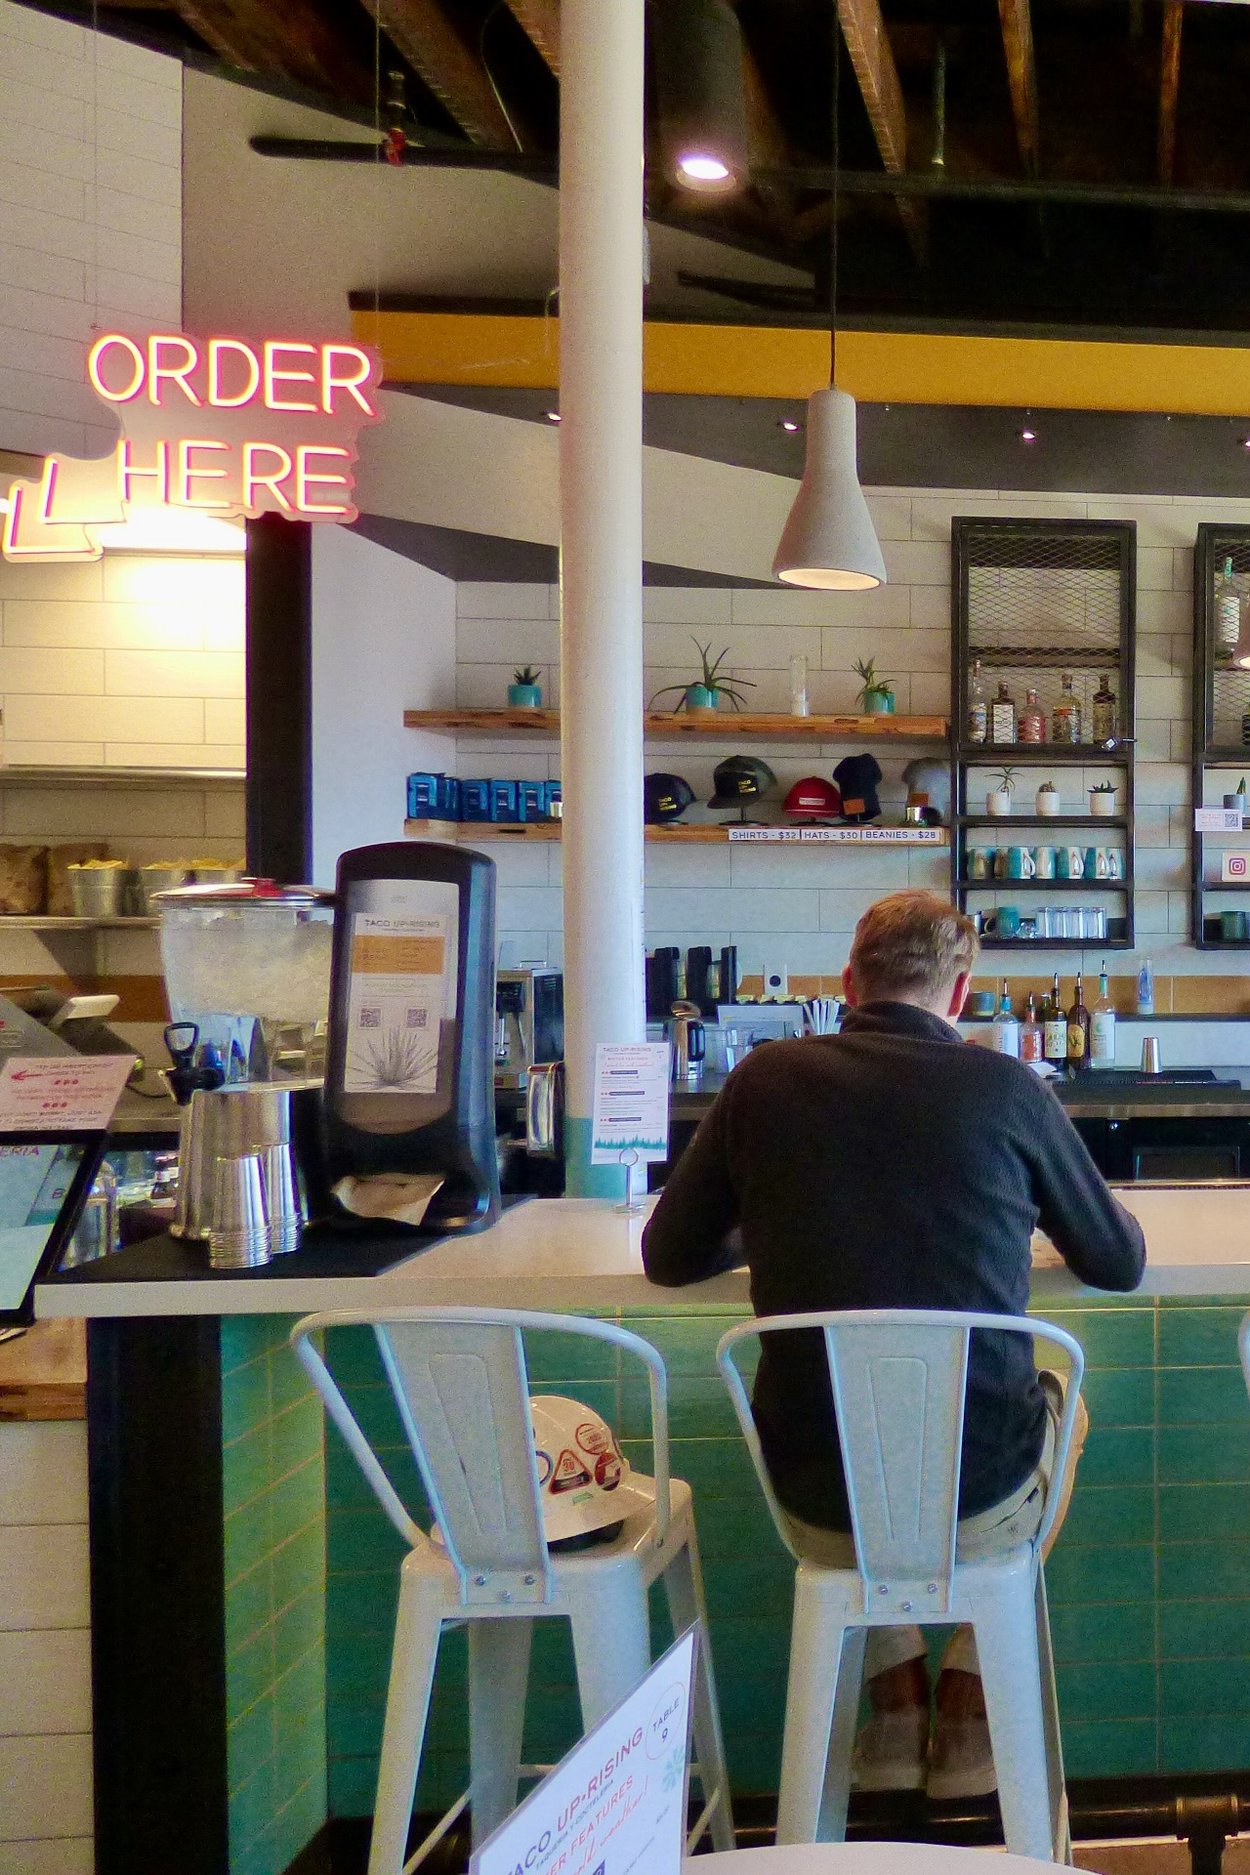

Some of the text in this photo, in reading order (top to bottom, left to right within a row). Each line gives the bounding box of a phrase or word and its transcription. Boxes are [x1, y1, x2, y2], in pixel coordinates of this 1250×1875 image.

[87, 332, 379, 418] ORDER
[116, 438, 353, 517] HERE
[731, 831, 769, 840] SHIRTS
[778, 831, 797, 841] $32
[804, 831, 830, 840] HATS
[839, 831, 858, 840] $30
[865, 830, 908, 839] BEANIES
[918, 830, 936, 839] $28
[651, 1697, 681, 1734] TABLE
[661, 1728, 669, 1744] 9
[570, 1775, 633, 1856] FEATURES
[508, 1830, 552, 1875] ACO
